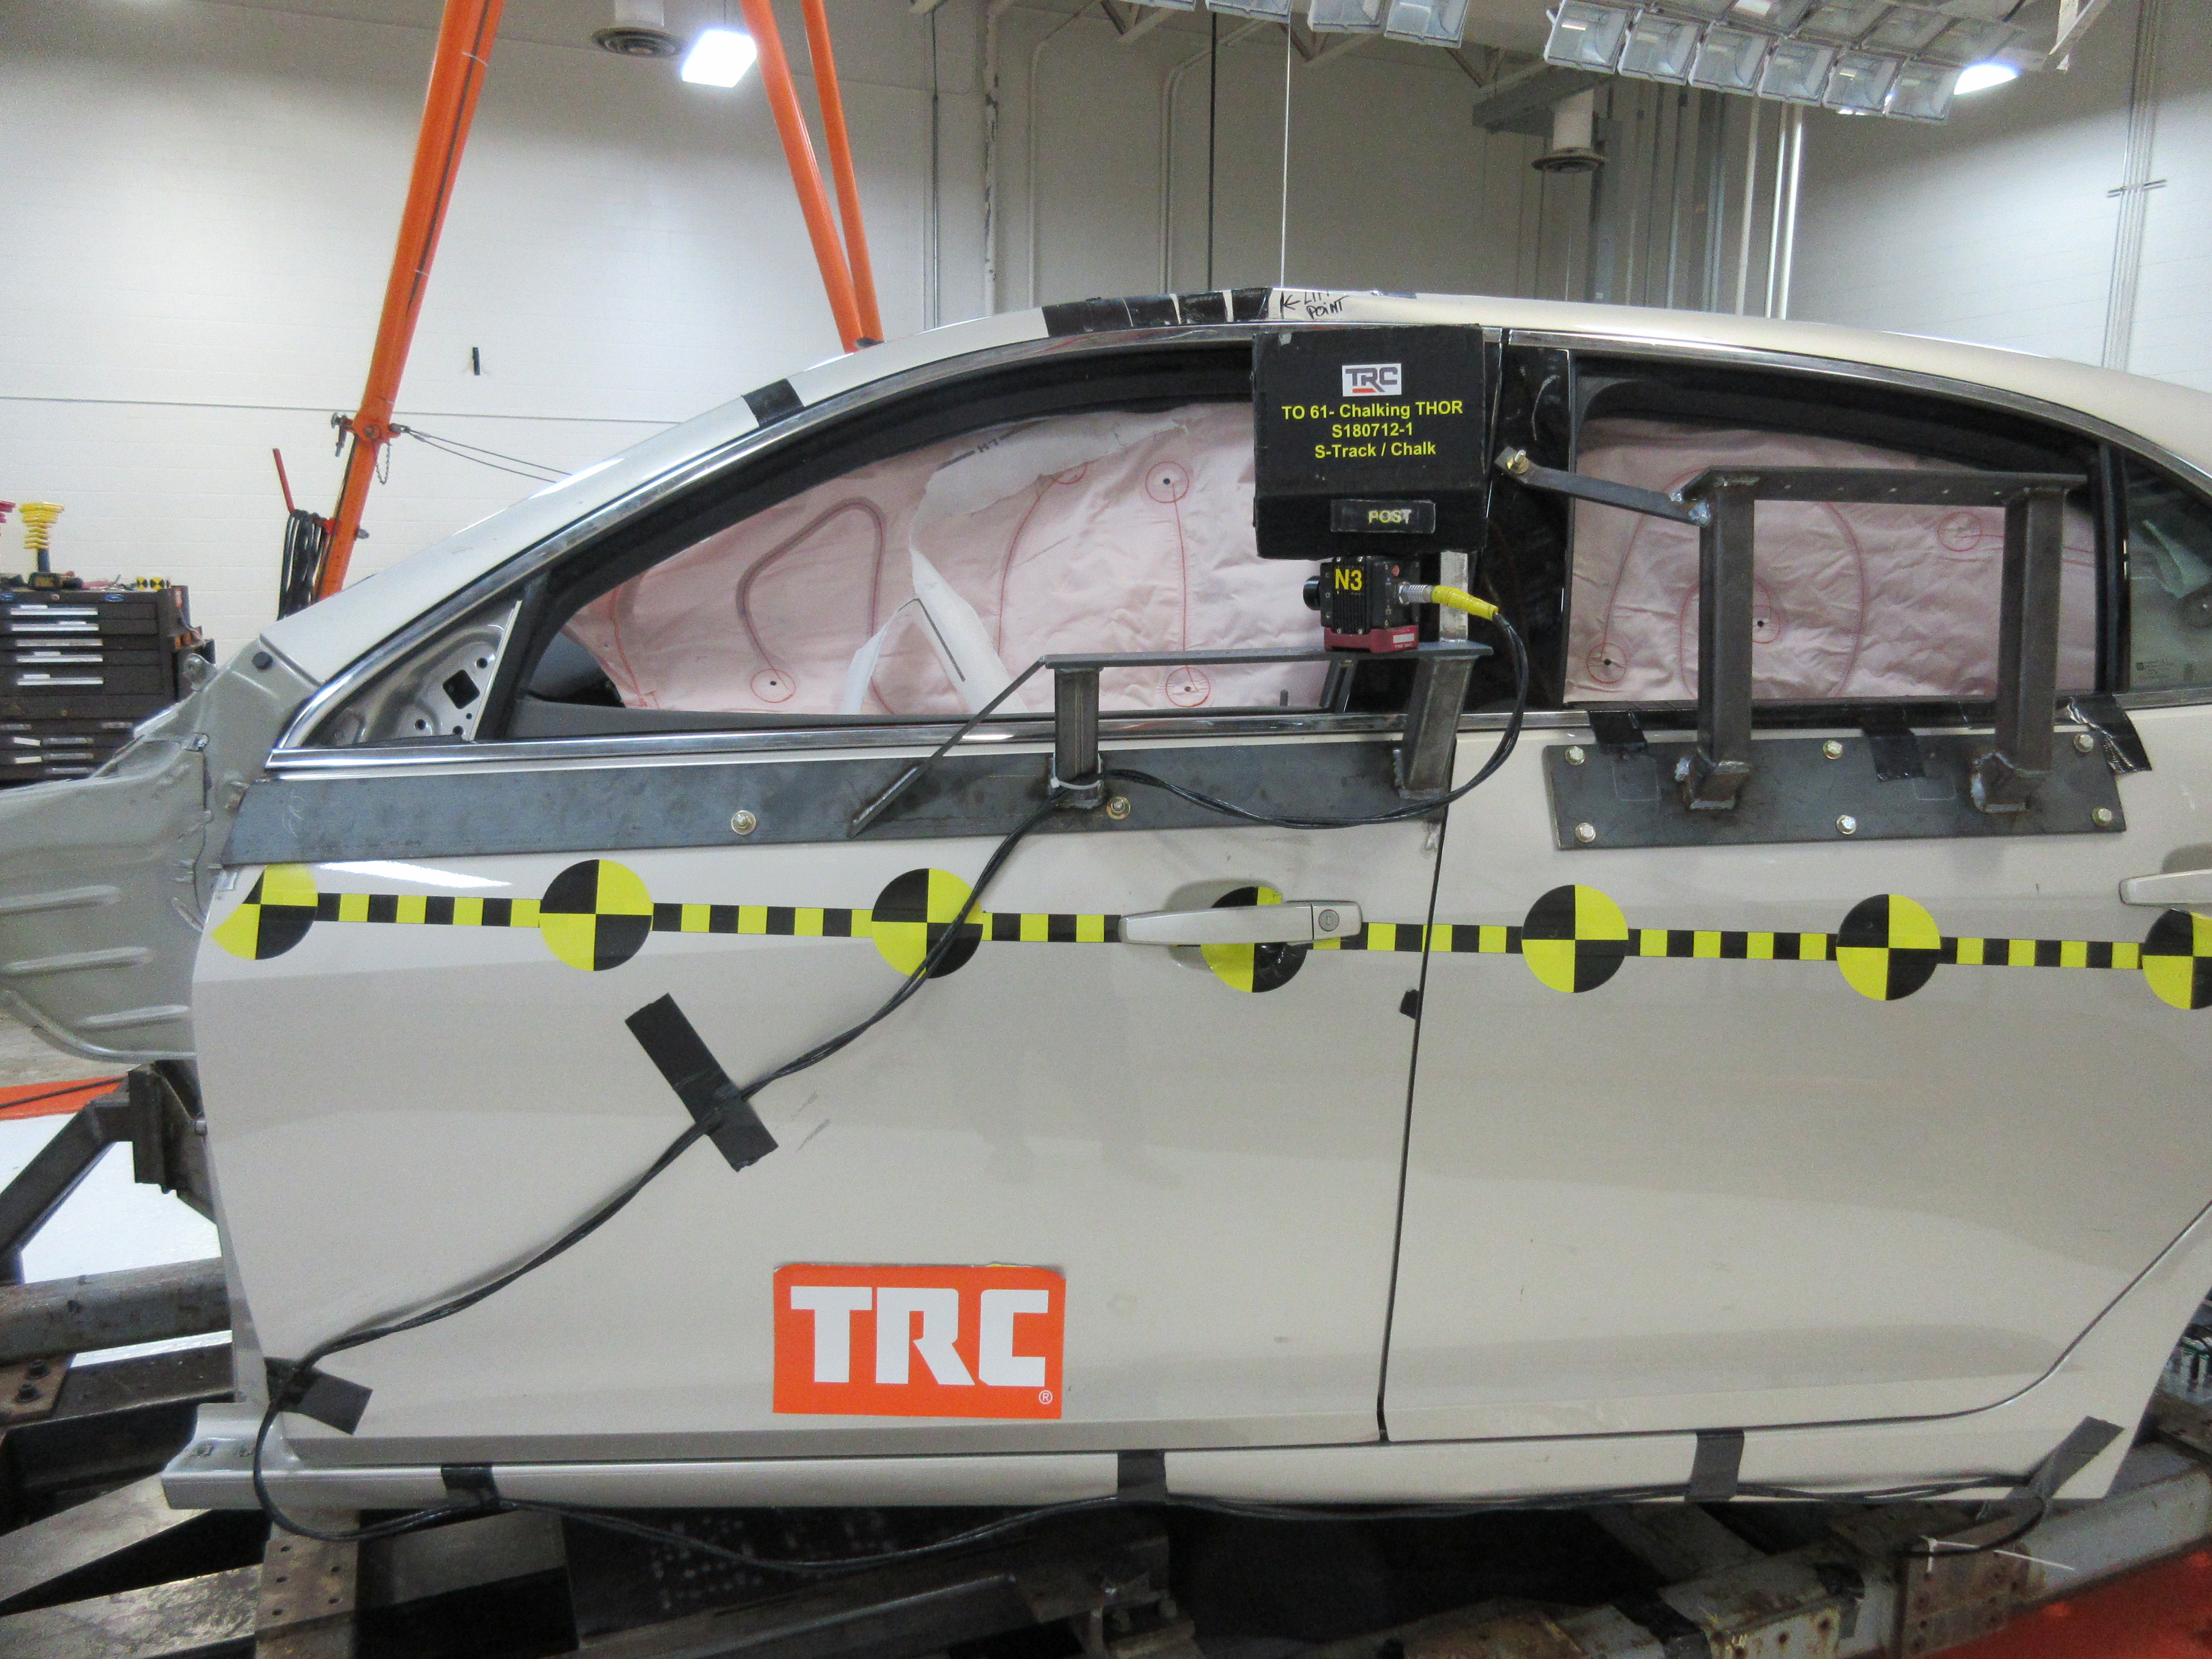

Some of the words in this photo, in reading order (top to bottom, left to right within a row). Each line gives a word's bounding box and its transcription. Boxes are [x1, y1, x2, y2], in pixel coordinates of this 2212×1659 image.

[1304, 290, 1330, 305] LI
[1345, 367, 1398, 393] TRC
[1281, 406, 1305, 420] TO
[1310, 405, 1335, 419] 61-
[1339, 403, 1410, 420] Chalking
[1415, 400, 1464, 416] THOR
[1332, 422, 1413, 438] S180712-1
[1314, 443, 1377, 459] S-Track
[1381, 443, 1386, 457] /
[1390, 442, 1437, 457] Chalk
[1369, 509, 1412, 524] POST
[1335, 568, 1362, 591] N3
[790, 1286, 1049, 1387] TRC
